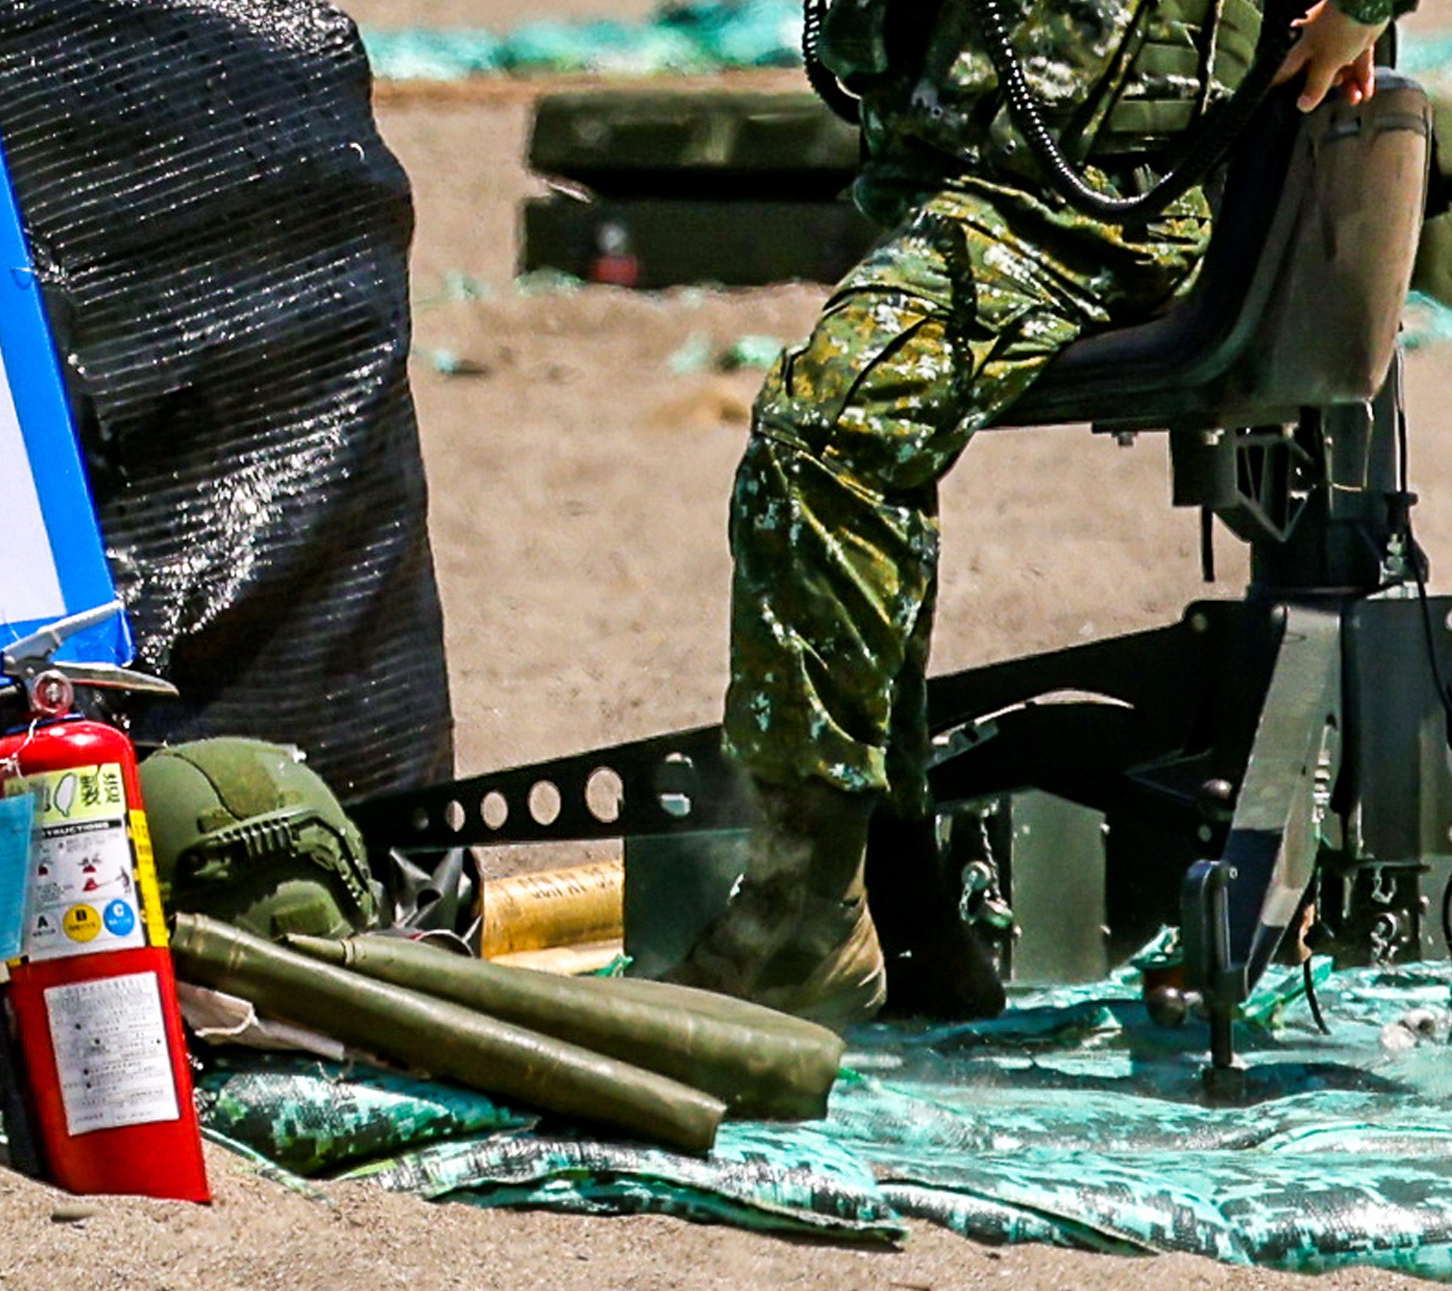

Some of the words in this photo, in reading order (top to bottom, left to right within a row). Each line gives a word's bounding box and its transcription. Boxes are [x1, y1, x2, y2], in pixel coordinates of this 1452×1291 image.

[37, 915, 49, 928] A
[75, 909, 87, 921] B
[112, 903, 125, 917] C
